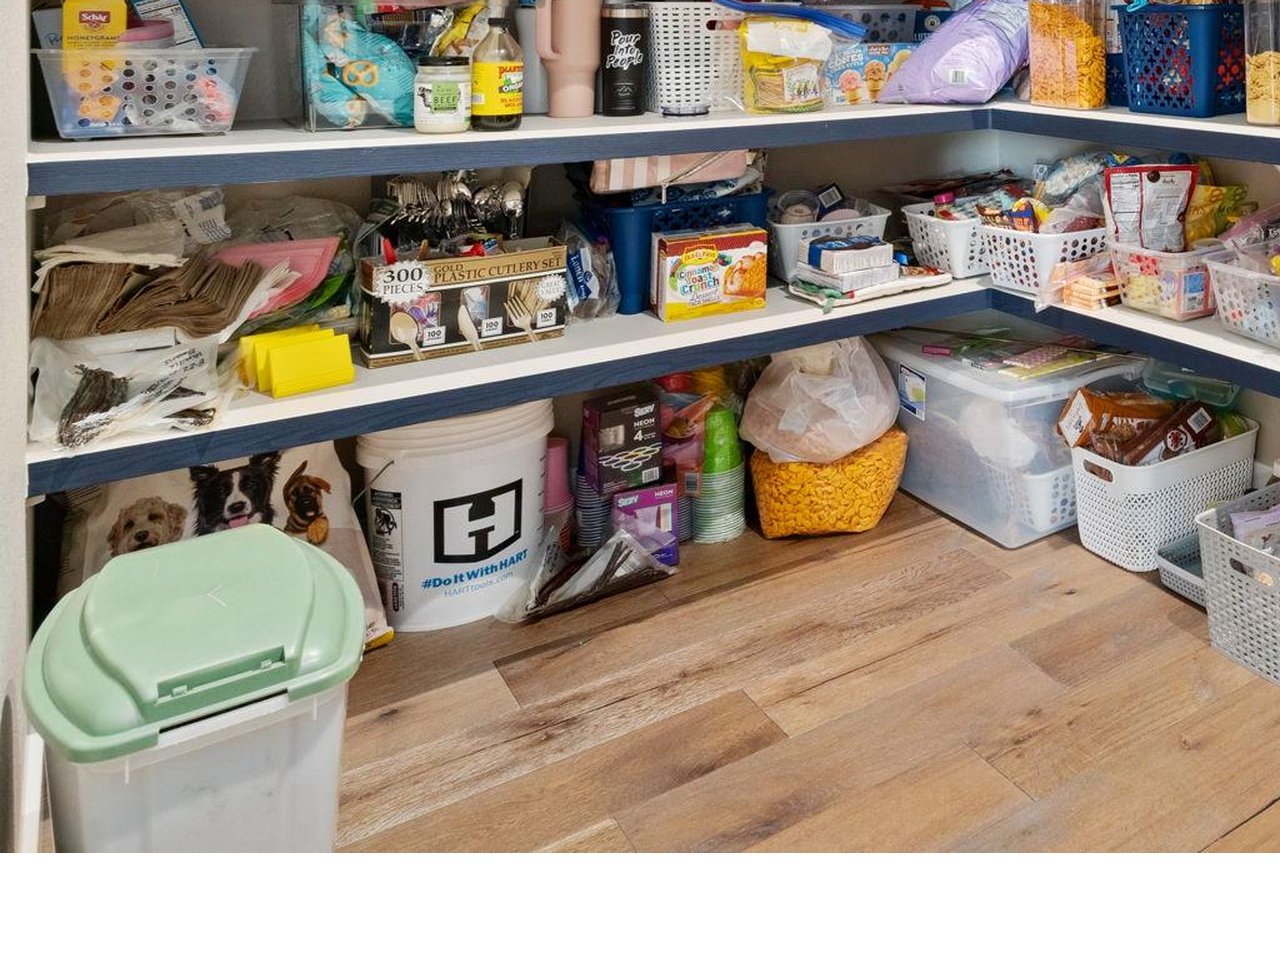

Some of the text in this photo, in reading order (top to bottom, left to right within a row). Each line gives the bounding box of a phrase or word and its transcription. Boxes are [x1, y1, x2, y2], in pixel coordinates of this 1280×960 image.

[610, 29, 642, 46] Pour
[605, 49, 644, 71] People
[433, 96, 457, 104] BEEF
[433, 264, 464, 273] GOLD
[434, 256, 561, 283] PLASTIC CUTLERY SET
[382, 267, 424, 284] 300
[382, 283, 424, 295] PIECES
[680, 276, 720, 296] Crunch
[540, 311, 554, 320] 100
[485, 321, 499, 329] 100
[427, 330, 442, 338] 100
[633, 417, 655, 428] NEON
[633, 429, 644, 442] 4
[654, 489, 674, 497] NEON
